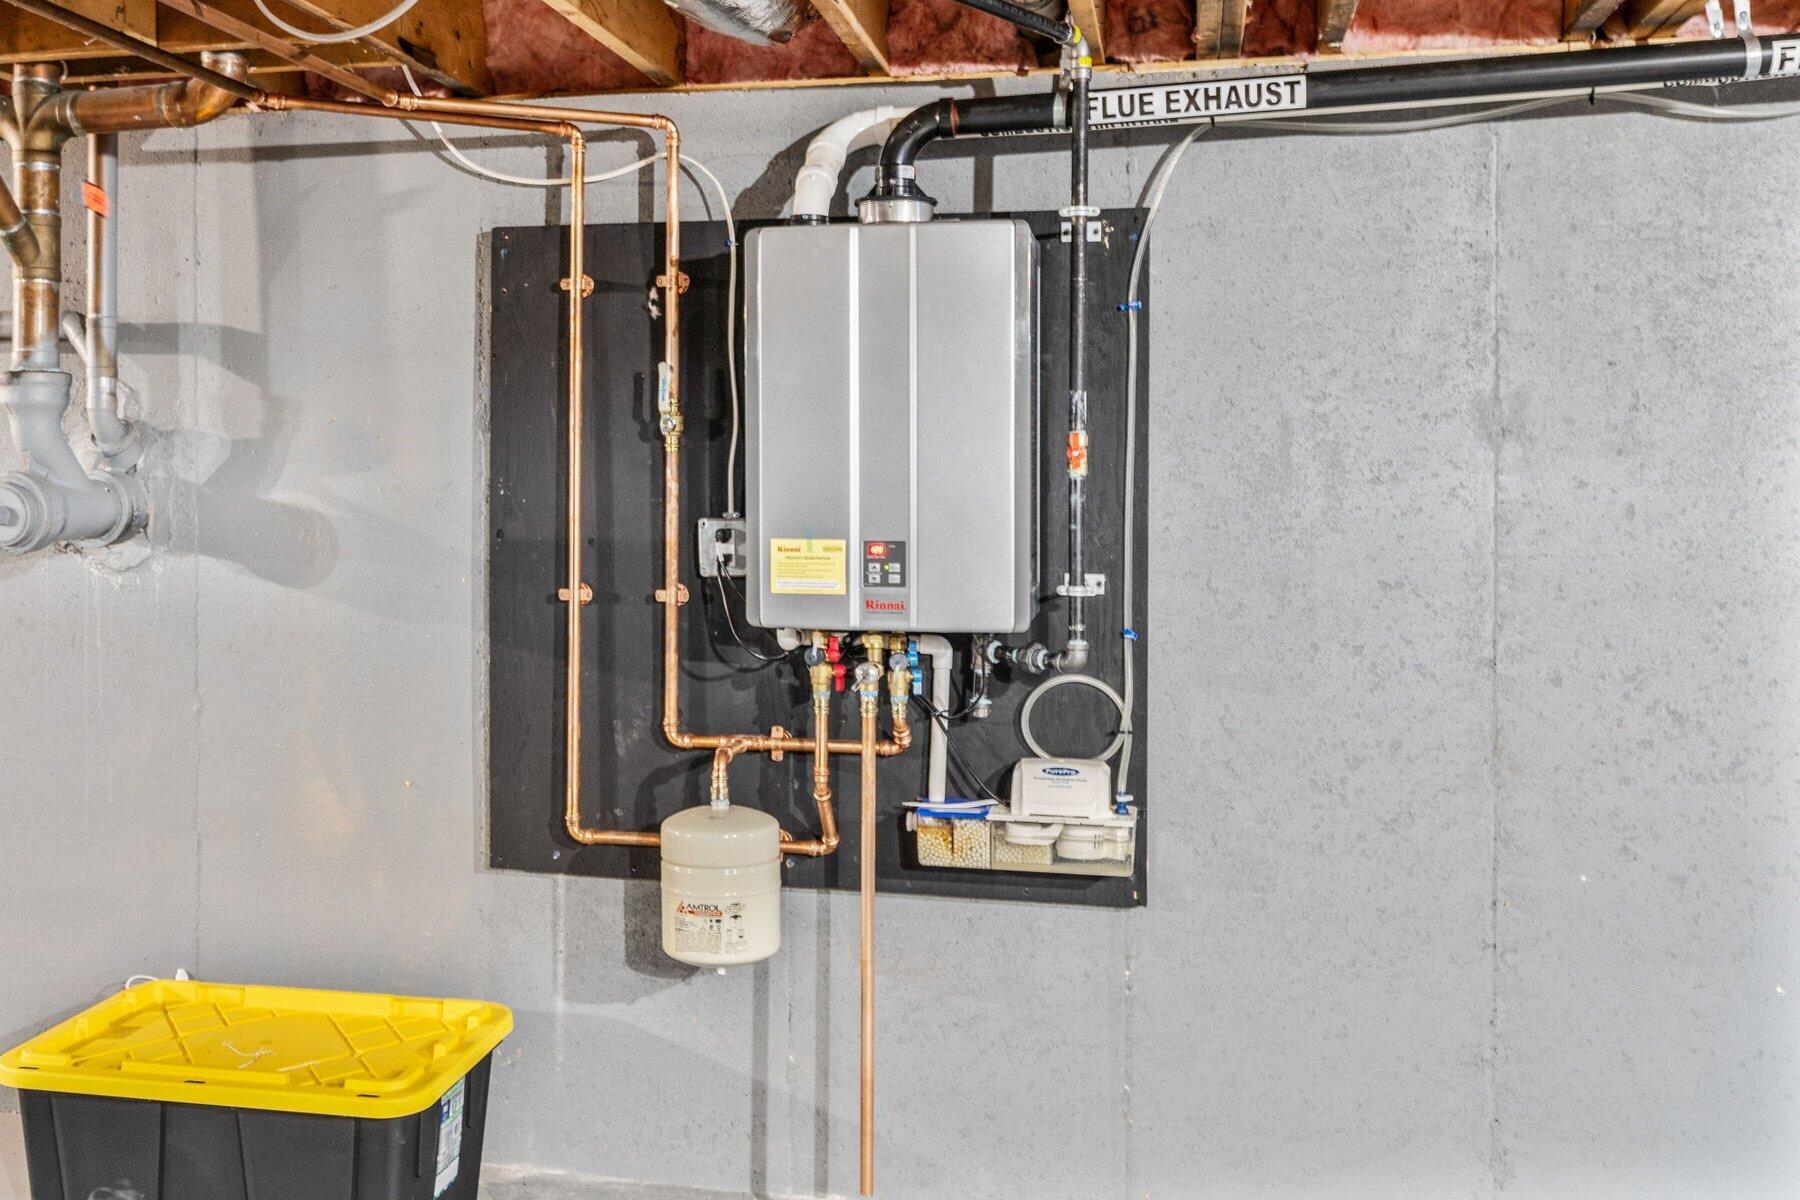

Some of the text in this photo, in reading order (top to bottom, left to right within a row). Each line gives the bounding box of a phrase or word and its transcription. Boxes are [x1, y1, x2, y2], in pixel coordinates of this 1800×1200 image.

[1088, 80, 1301, 120] FLUE EXHAUST
[865, 600, 905, 610] Rinnai
